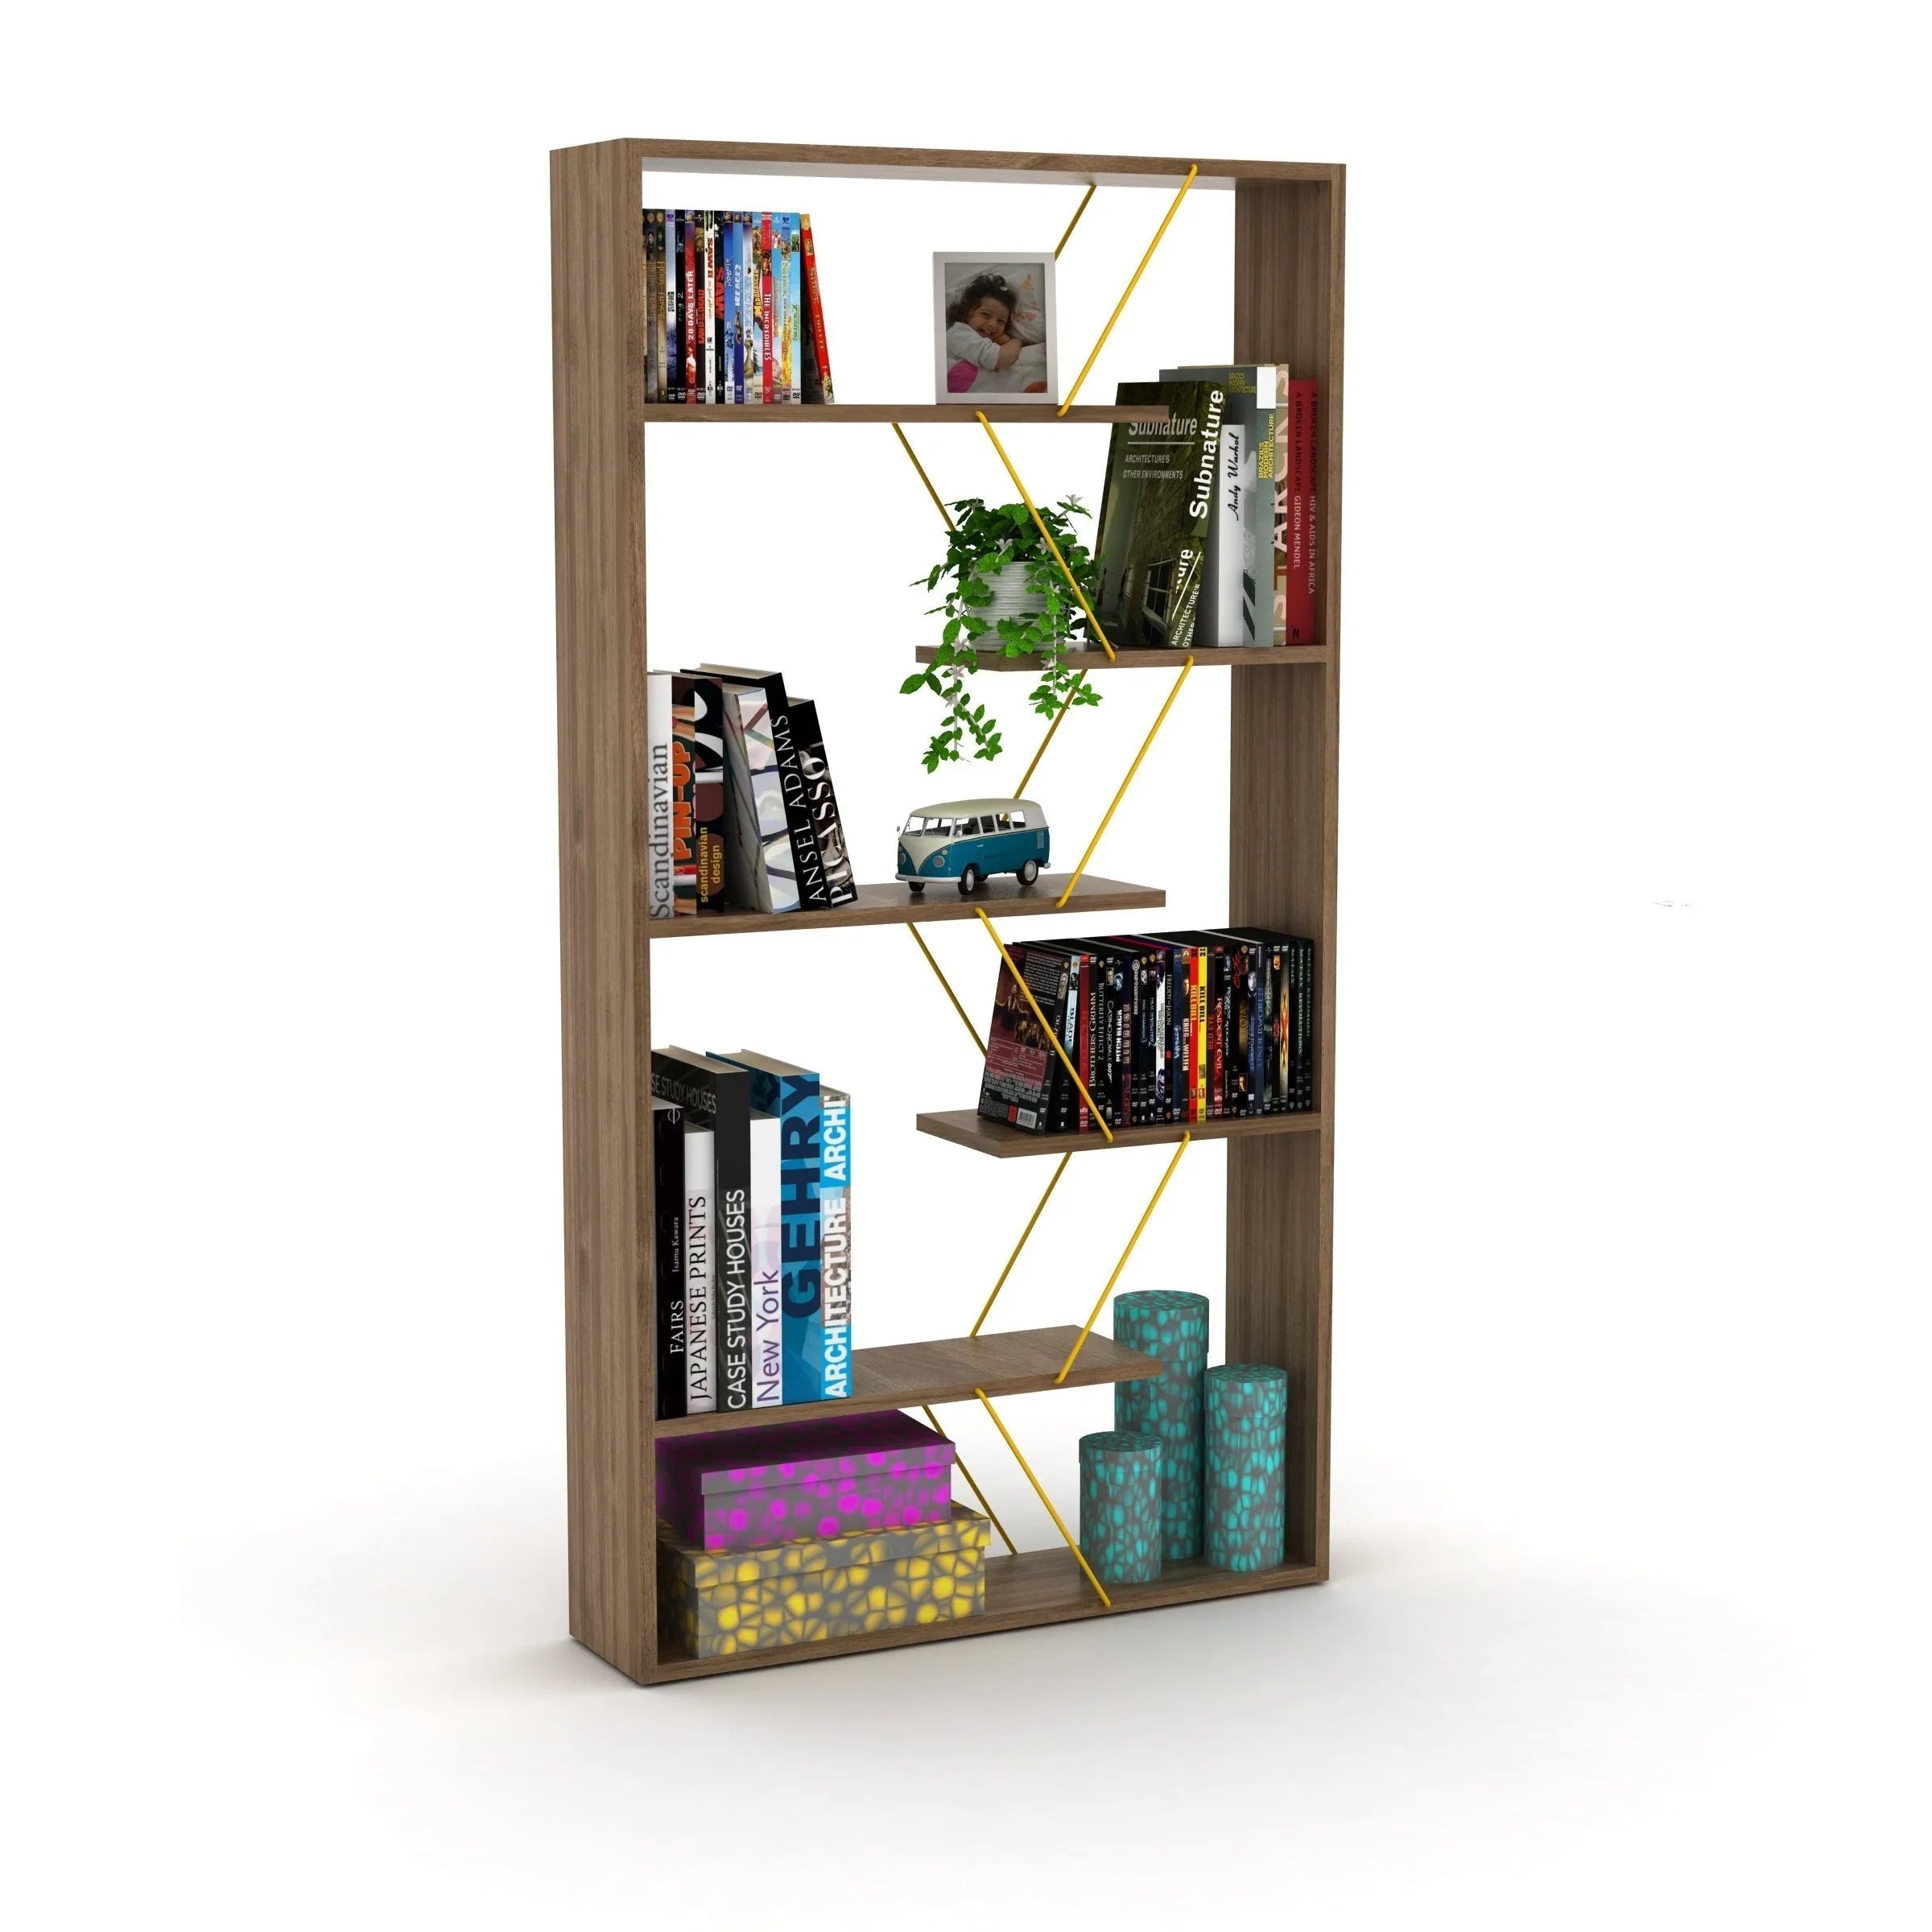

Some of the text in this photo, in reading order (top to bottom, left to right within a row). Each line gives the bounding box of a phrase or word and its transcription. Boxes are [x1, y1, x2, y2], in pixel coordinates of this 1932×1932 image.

[687, 329, 695, 340] 28
[716, 266, 724, 320] SAW
[1123, 469, 1183, 480] OTHER ENVIRONMENTS
[1125, 454, 1170, 464] ARCHITECTURE'S
[1189, 390, 1224, 519] Subnature
[1228, 432, 1241, 521] Andy Warhol
[1309, 548, 1315, 559] IN
[649, 743, 670, 919] Scandinavian
[673, 741, 692, 861] PIN-UP
[770, 715, 827, 902] ANSEL ADAMS
[802, 757, 853, 909] PICASSO
[699, 827, 708, 902] scandinavian
[711, 844, 723, 884] design
[1106, 1001, 1114, 1034] CASINO
[662, 1077, 685, 1102] STUDY
[687, 1085, 716, 1114] HOUSES
[781, 1075, 820, 1319] GEHRY
[824, 1096, 848, 1399] ARCHITECTURE ARCHI
[671, 1300, 683, 1354] FAIRS
[689, 1196, 712, 1402] JAPANESE PRINTS
[726, 1189, 746, 1409] CASE STUDY HOUSES
[753, 1269, 779, 1402] New York
